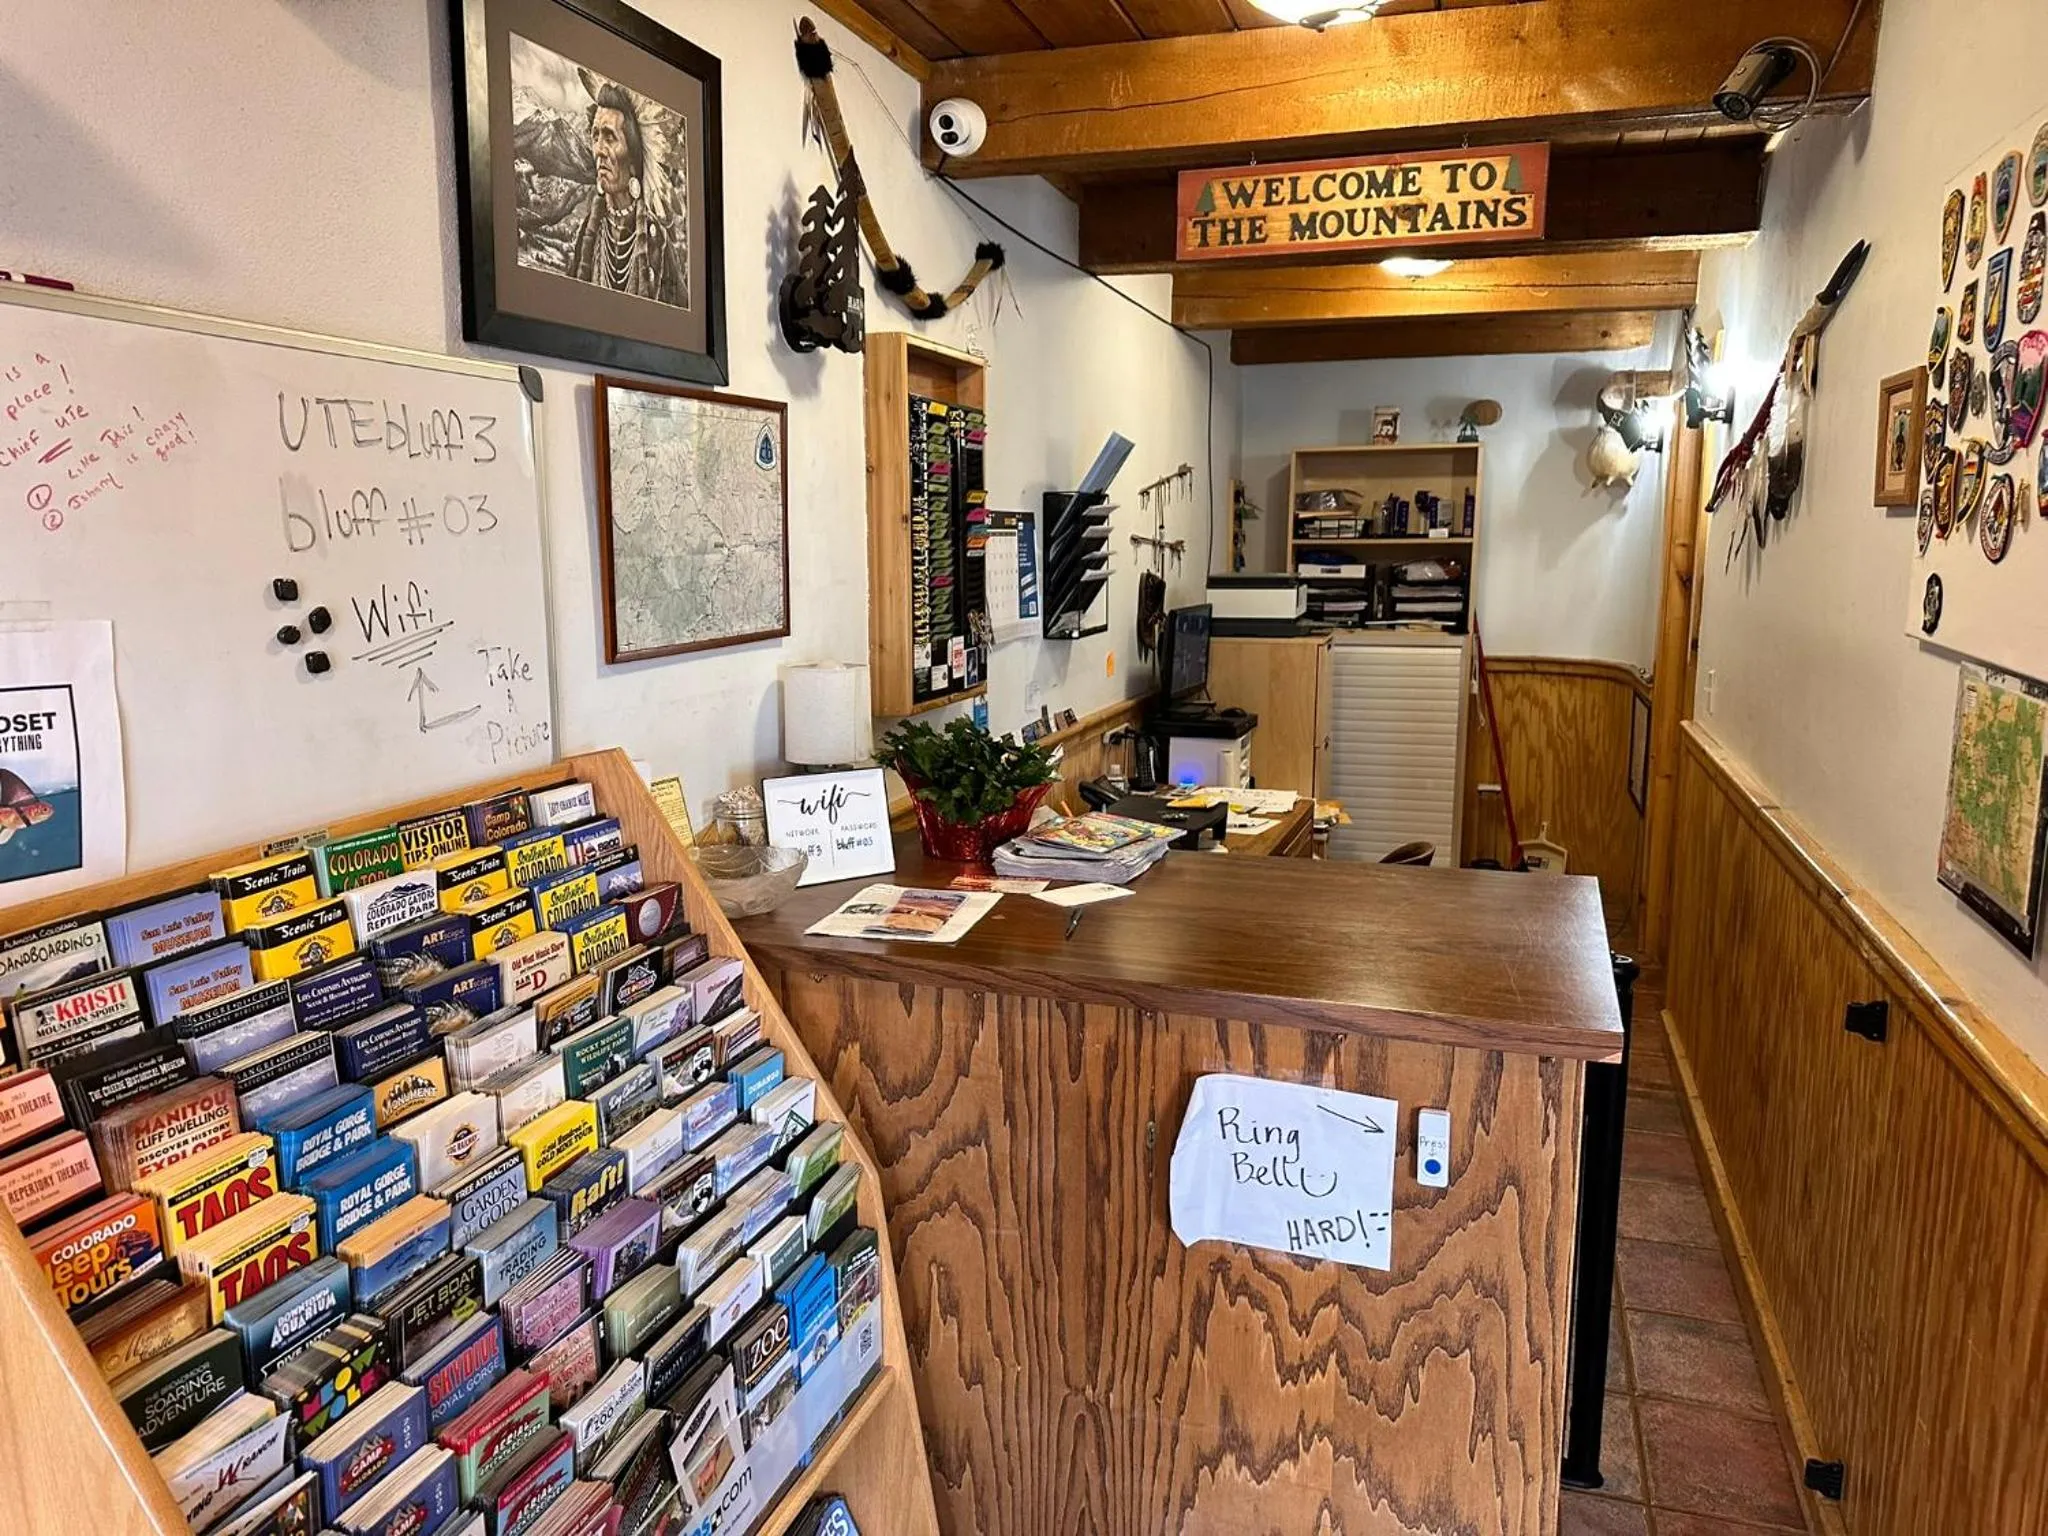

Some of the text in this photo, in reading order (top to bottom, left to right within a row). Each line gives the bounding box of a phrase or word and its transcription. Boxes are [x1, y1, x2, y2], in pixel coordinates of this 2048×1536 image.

[1222, 161, 1498, 210] WELCOME TO
[1191, 198, 1527, 248] THE MOUNTAINS
[352, 581, 433, 643] Wifi
[477, 646, 533, 687] Take
[486, 721, 550, 764] Picture
[485, 811, 510, 826] Camp
[778, 784, 872, 825] wifi
[401, 818, 465, 849] VISITOR
[405, 836, 468, 865] TIPS ONLINE
[486, 820, 527, 841] Colorado
[239, 863, 307, 892] Scenic Train
[329, 842, 399, 876] COLORADO
[447, 857, 501, 883] Scenic Train
[514, 855, 565, 887] COLORADO
[275, 908, 343, 940] Scenic Train
[367, 889, 436, 922] COLORADO GATORS
[367, 900, 436, 932] REPTILE PARK
[477, 899, 528, 926] Scenic Train
[579, 934, 626, 970] COLORADO
[55, 982, 127, 1021] KRISTI
[531, 969, 547, 991] D
[36, 1002, 126, 1038] MOUNTAIN SPORTS
[135, 1090, 228, 1138] MANITOU
[136, 1104, 230, 1151] CLIFF DWELLINGS
[302, 1108, 368, 1154] ROYAL GORGE
[1218, 1107, 1300, 1163] Ring
[137, 1121, 231, 1166] DISCOVER HISTORY
[296, 1121, 373, 1173] BRIDGE & PARK
[1420, 1135, 1446, 1150] Press
[340, 1163, 407, 1211] ROYAL GORGE
[456, 1155, 520, 1202] FREE ATTRACTION
[571, 1158, 625, 1222] Raft!
[1232, 1151, 1297, 1188] Bell
[176, 1166, 274, 1240] TAOS
[336, 1177, 412, 1234] BRIDGE & PARK
[461, 1175, 519, 1223] GARDEN
[478, 1192, 521, 1231] GODS
[51, 1213, 137, 1265] COLORADO
[1286, 1209, 1371, 1252] HARD!
[220, 1232, 311, 1311] TAOS
[499, 1236, 547, 1281] TRADING
[509, 1255, 538, 1287] POST
[57, 1257, 133, 1310] Tours
[408, 1265, 477, 1326] JET BOAT
[270, 1291, 338, 1350] AQUARIUM
[751, 1314, 789, 1371] ZOO
[428, 1326, 499, 1408] SKYDIVE
[138, 1376, 227, 1437] ADVENTURE
[144, 1371, 214, 1420] SOARING
[432, 1388, 465, 1422] ROYAL
[466, 1358, 501, 1393] GORGE
[351, 1447, 383, 1477] CAMP
